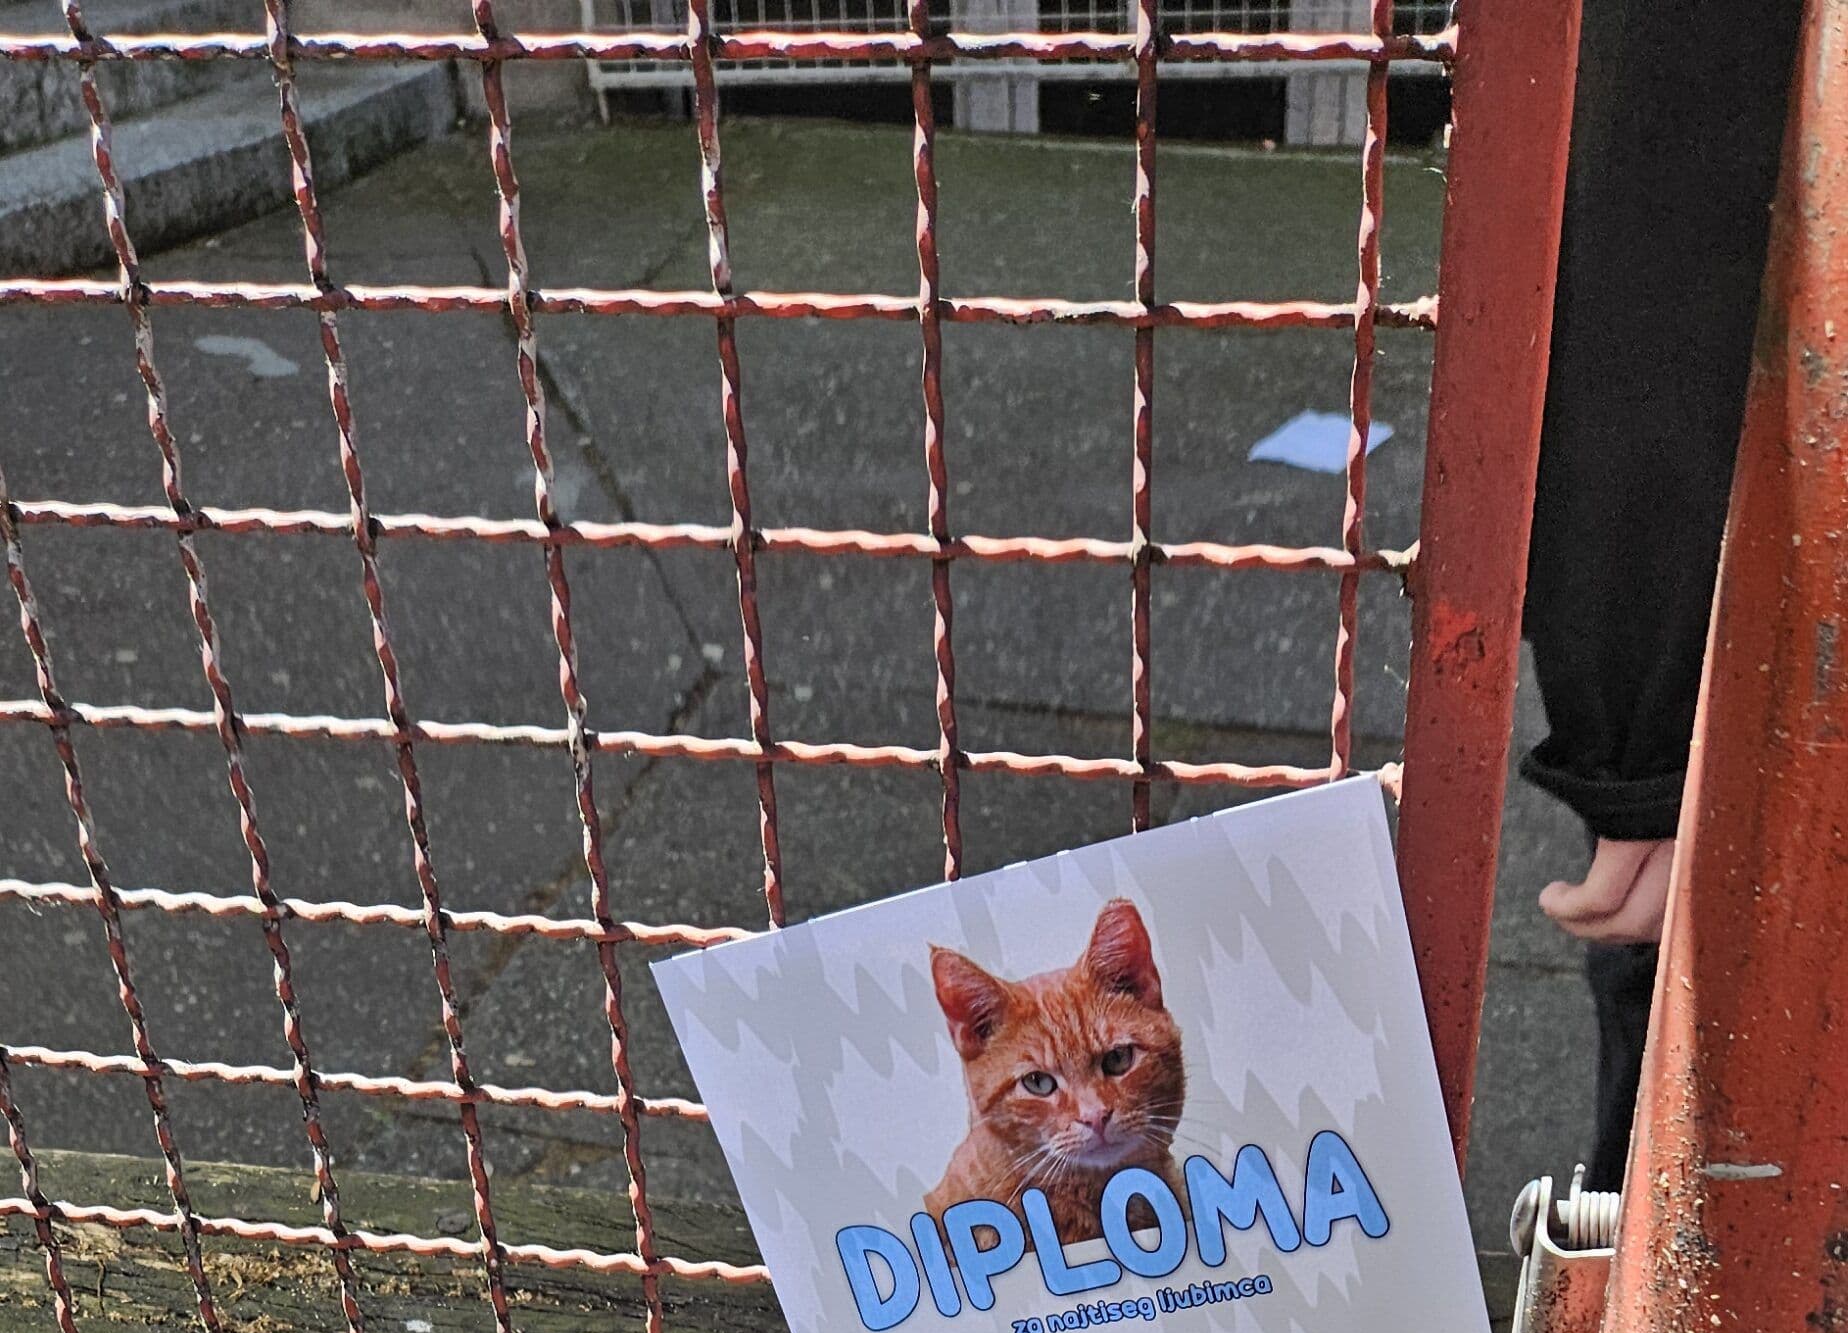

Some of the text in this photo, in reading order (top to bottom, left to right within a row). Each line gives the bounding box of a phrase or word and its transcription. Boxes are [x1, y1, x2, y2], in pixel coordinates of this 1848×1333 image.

[835, 1130, 1390, 1331] DIPLOMA
[1046, 1297, 1157, 1333] najtiseg
[1156, 1274, 1274, 1313] ljubimca
